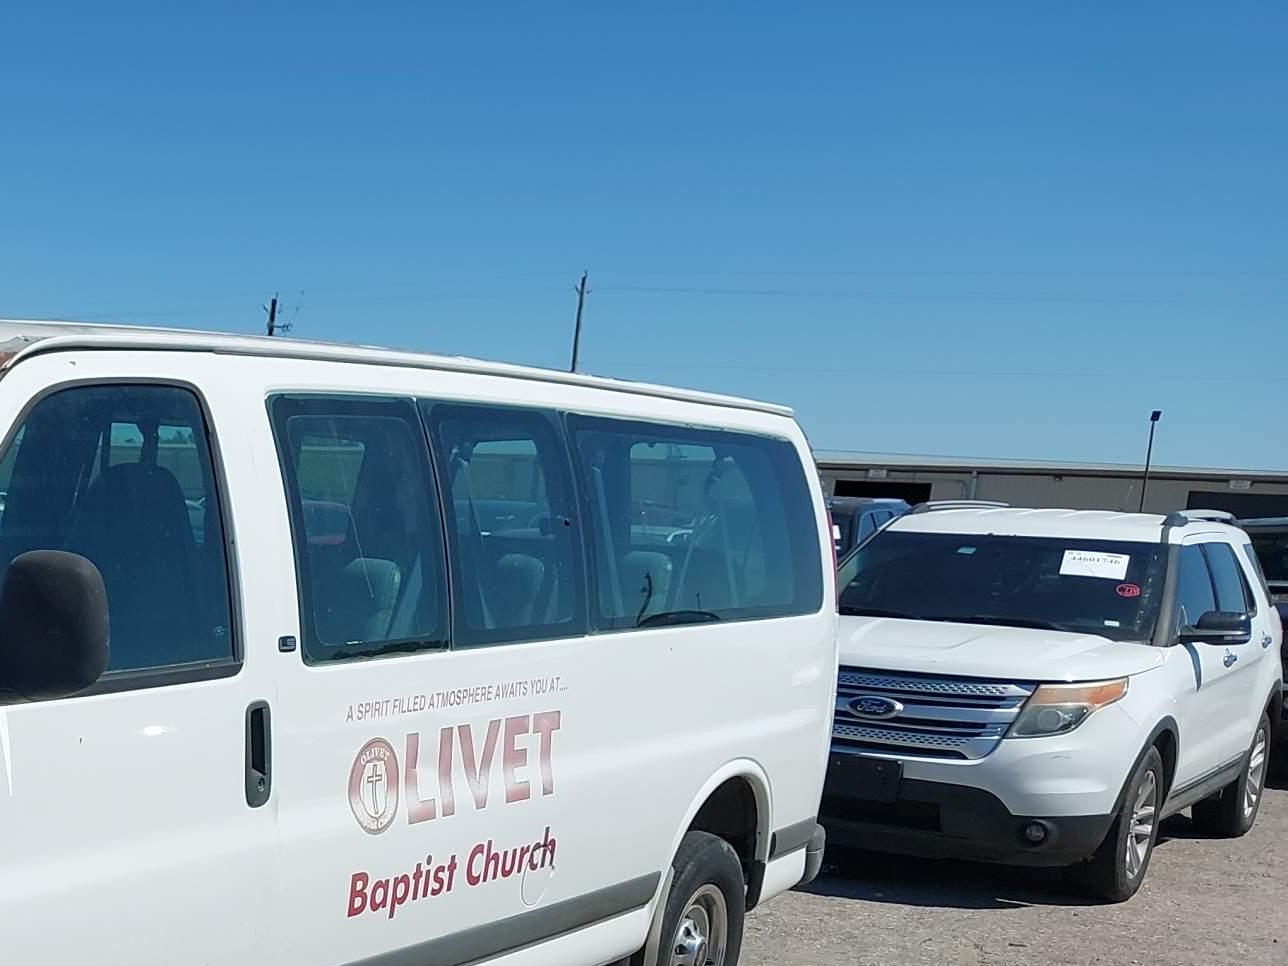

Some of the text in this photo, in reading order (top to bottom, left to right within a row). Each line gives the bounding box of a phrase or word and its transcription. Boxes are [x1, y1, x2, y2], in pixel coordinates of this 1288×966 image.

[346, 704, 354, 722] A
[357, 699, 390, 721] SPIRIT
[392, 694, 426, 715] FILLED
[428, 685, 493, 710] ATMOSPHERE
[494, 680, 529, 700] AWAITS
[530, 678, 548, 696] YOU
[856, 699, 888, 713] Ford
[360, 746, 390, 765] OLIVET
[346, 826, 557, 919] Baptist Church
